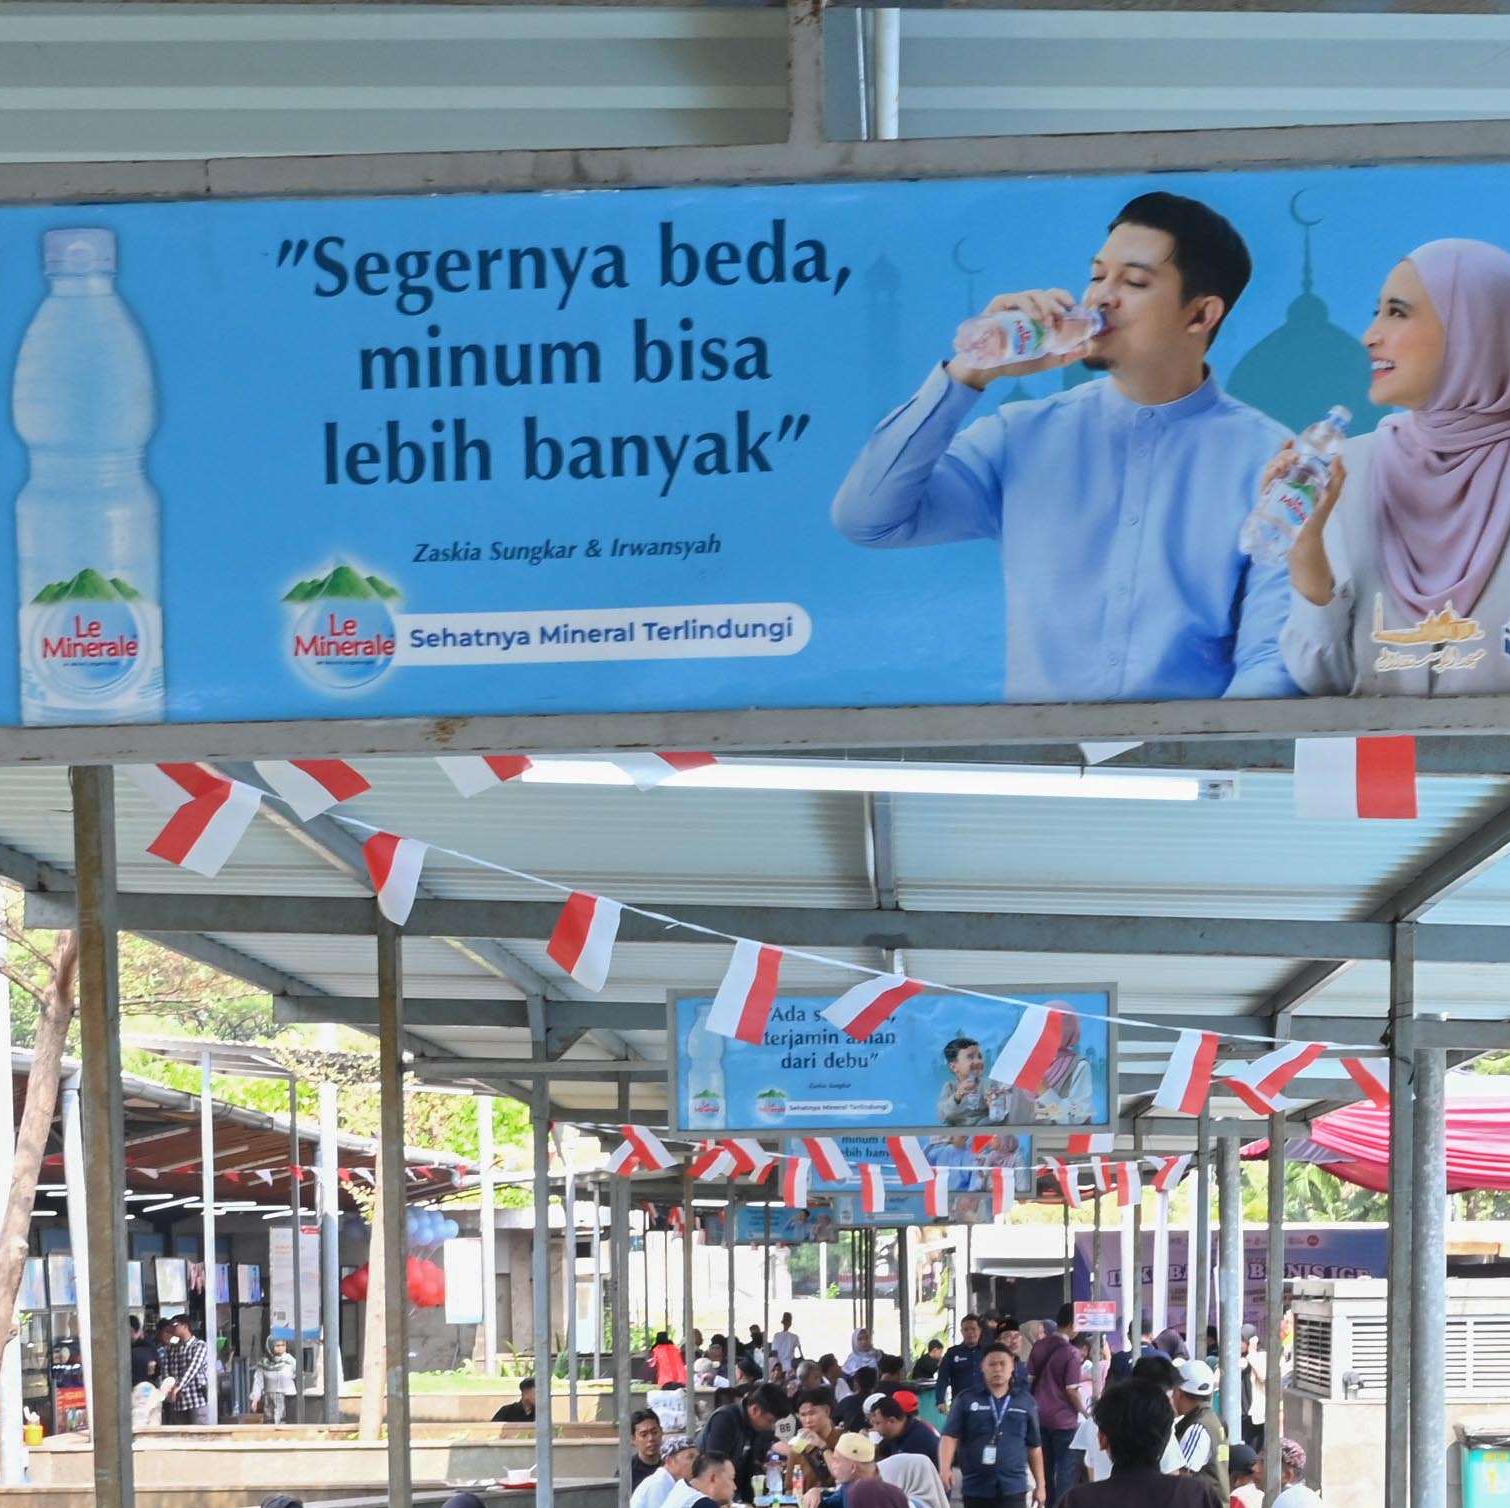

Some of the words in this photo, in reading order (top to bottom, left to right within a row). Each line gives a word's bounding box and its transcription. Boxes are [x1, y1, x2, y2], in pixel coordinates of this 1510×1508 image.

[659, 218, 853, 295] beda,
[360, 324, 601, 390] minum
[634, 317, 772, 384] bisa
[325, 418, 492, 486] lebih
[412, 541, 482, 563] Zaskia
[490, 540, 578, 566] Sungkar
[585, 539, 602, 557] &
[610, 534, 722, 561] Irwansyah
[75, 615, 101, 638] Le
[329, 613, 357, 637] Le
[410, 627, 530, 651] Sehatnya
[539, 621, 635, 645] Mineral
[641, 615, 794, 643] Terlindungi
[42, 635, 138, 659] Minerale
[294, 634, 395, 657] Minerale
[764, 1026, 839, 1049] terjamin
[781, 1052, 816, 1069] dari
